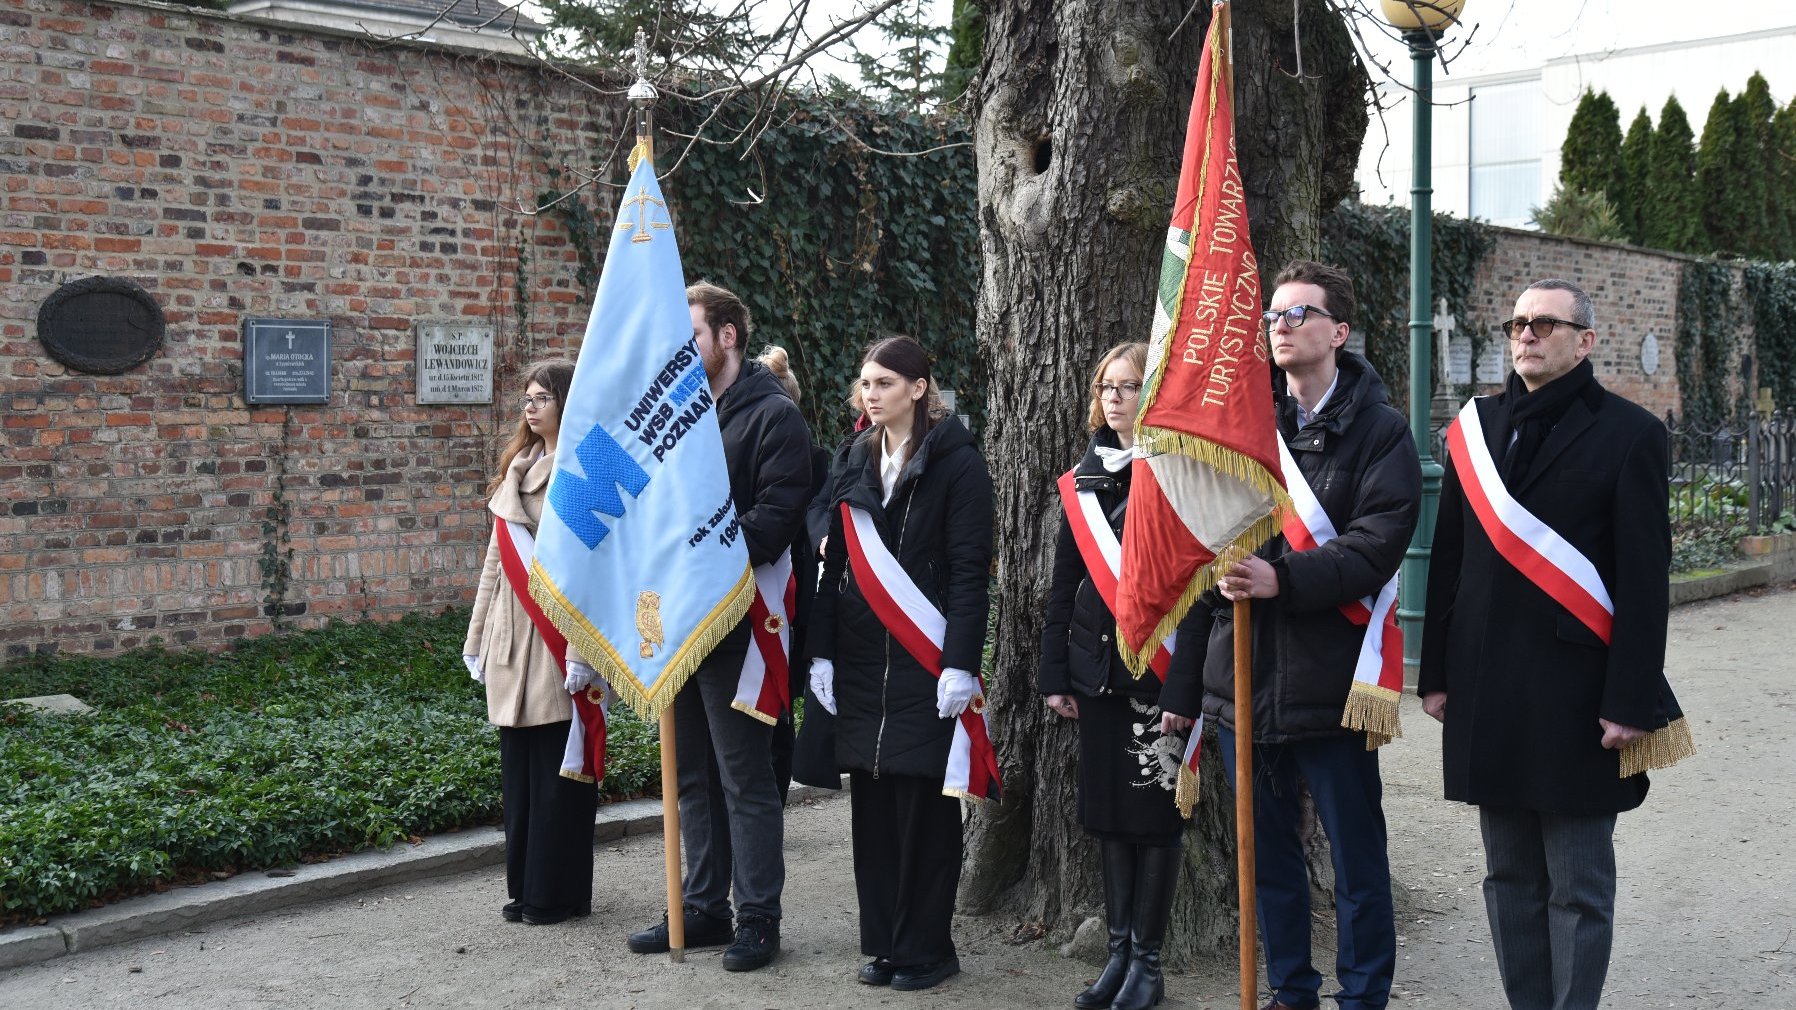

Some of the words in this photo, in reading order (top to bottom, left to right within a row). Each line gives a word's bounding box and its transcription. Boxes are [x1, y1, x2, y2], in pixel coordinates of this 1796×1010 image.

[1183, 270, 1228, 365] POLSKIE
[271, 353, 290, 361] MARIA
[290, 353, 314, 361] OTOCKA
[433, 344, 479, 356] WOJCIECH
[424, 358, 489, 370] LEWANDOWICZ
[639, 402, 674, 446] WSB
[652, 387, 713, 463] POZNAŃ
[689, 526, 710, 547] rok
